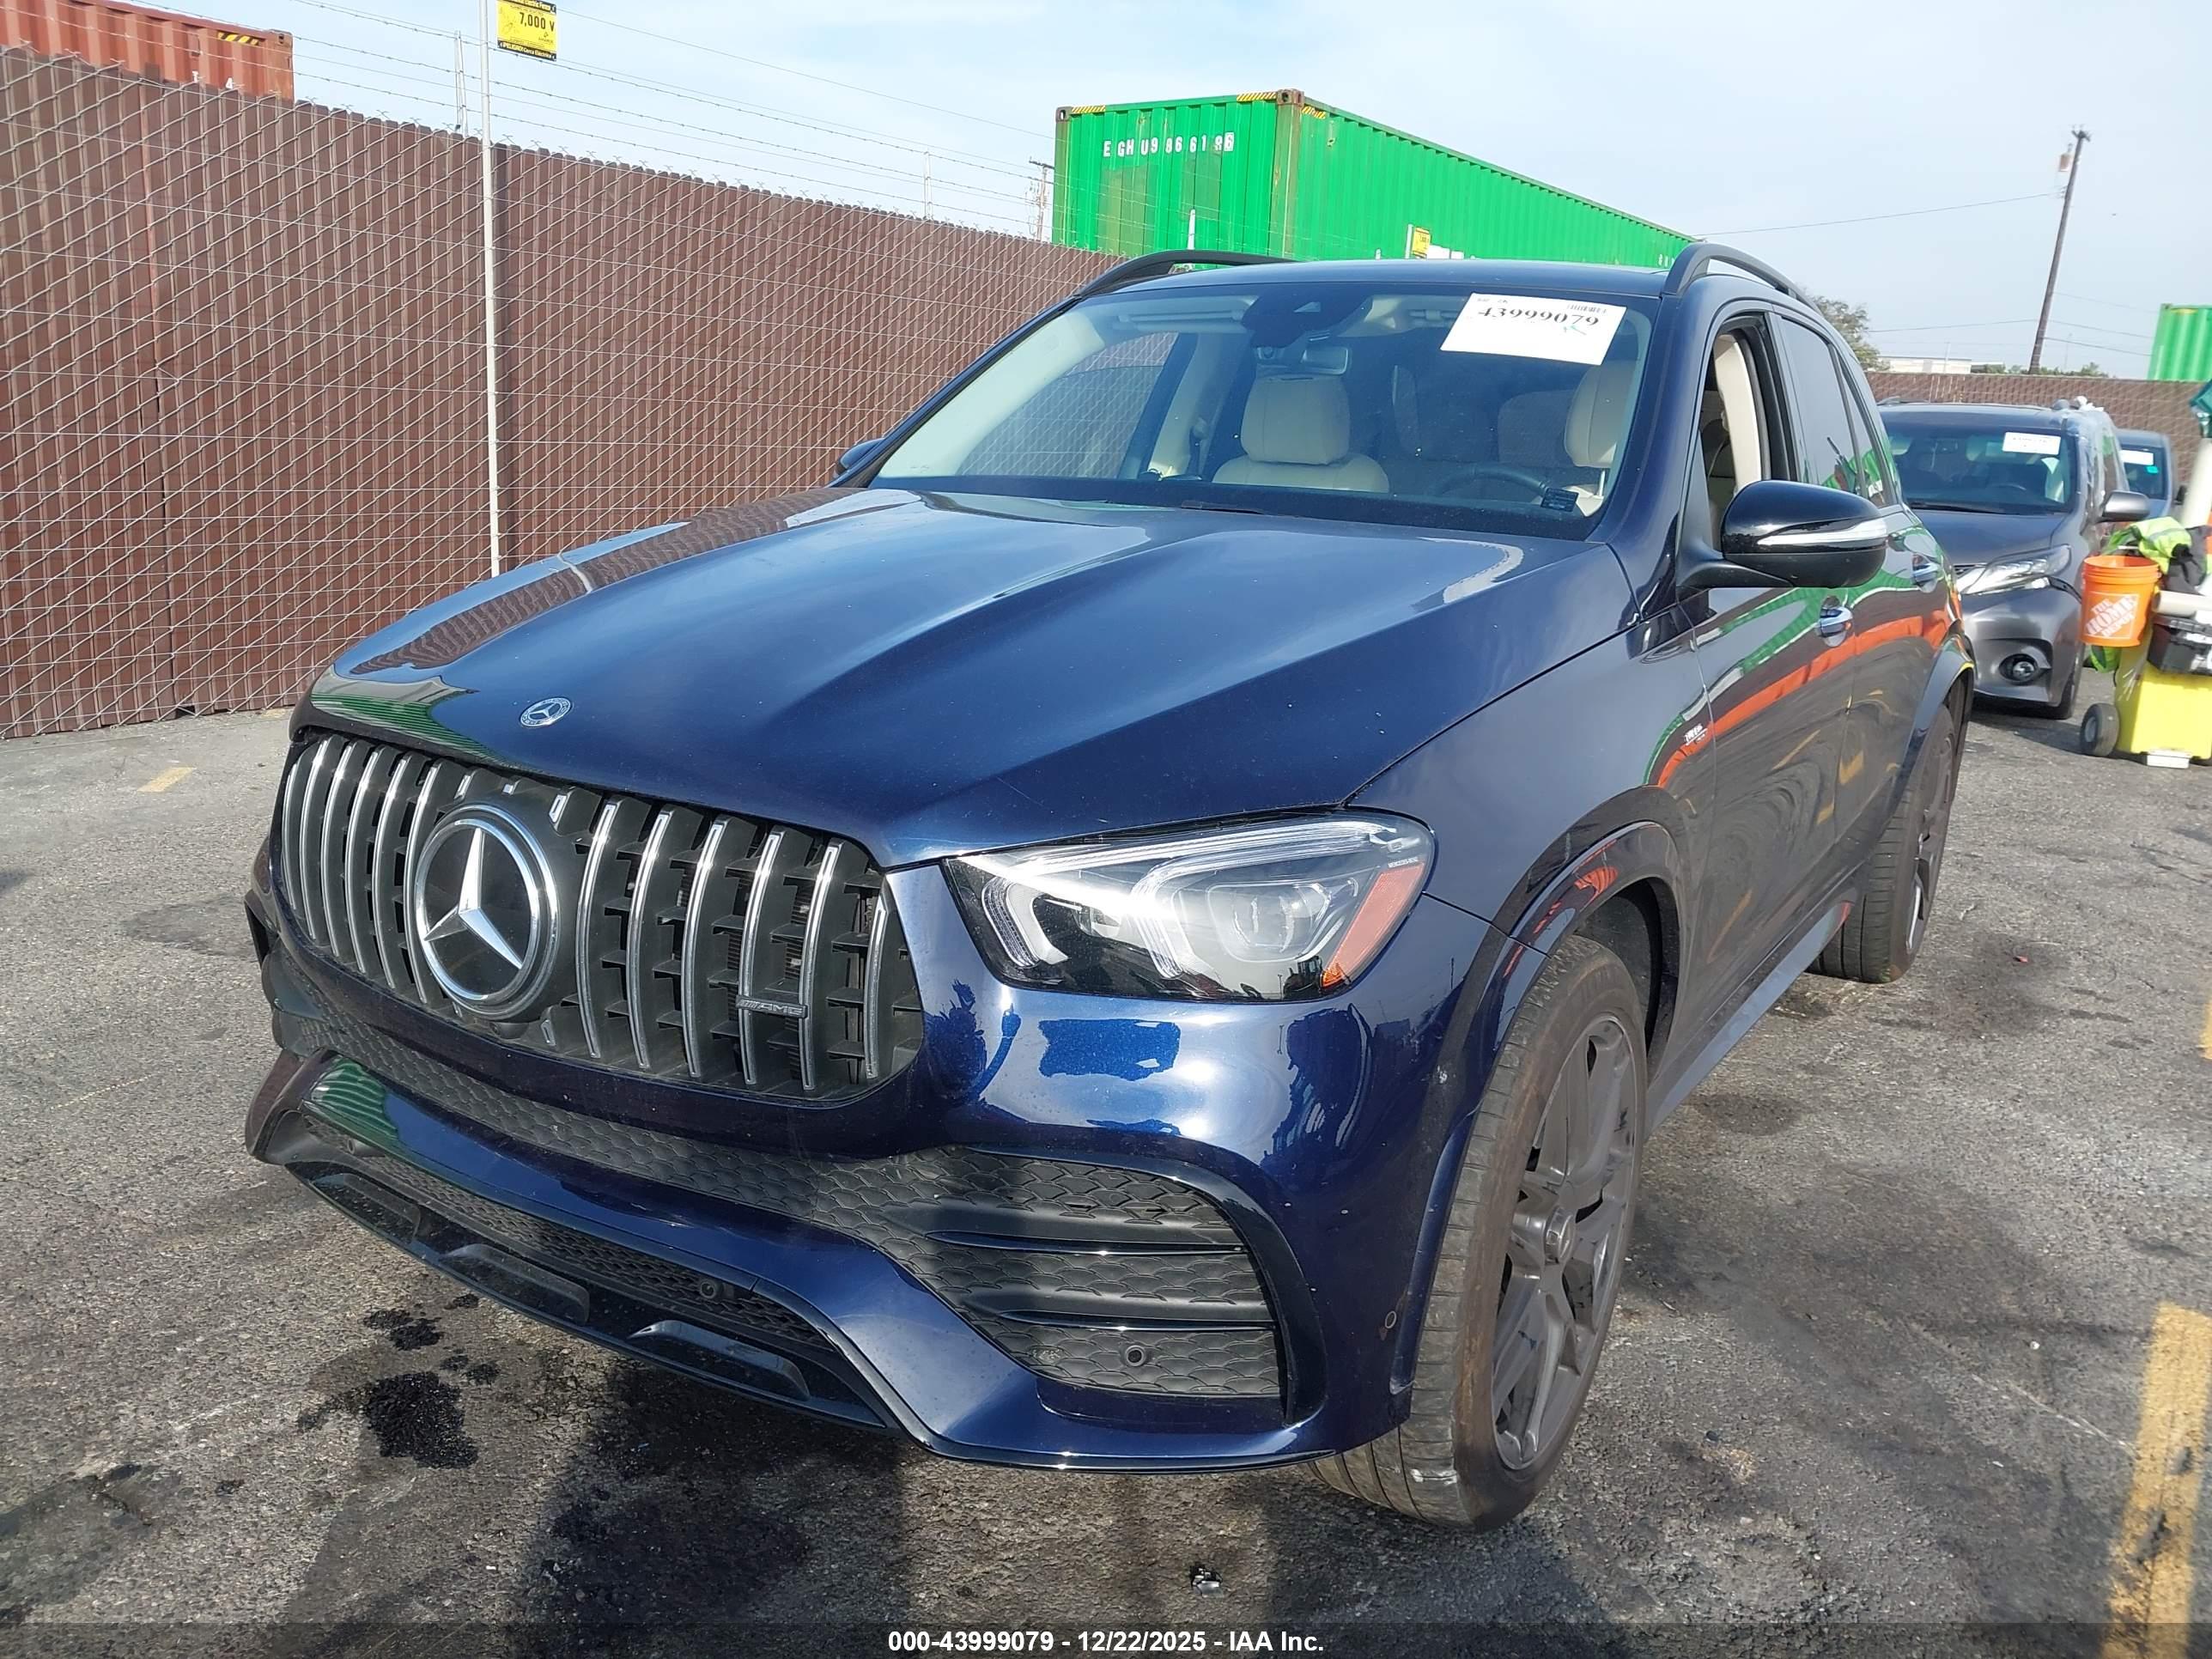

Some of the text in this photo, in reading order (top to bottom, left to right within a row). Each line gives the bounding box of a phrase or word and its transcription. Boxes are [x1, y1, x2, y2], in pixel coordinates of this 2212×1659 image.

[520, 12, 555, 32] 7,000 V
[1477, 307, 1599, 325] 43999079
[2087, 595, 2136, 635] HOME
[757, 1002, 803, 1016] AMG
